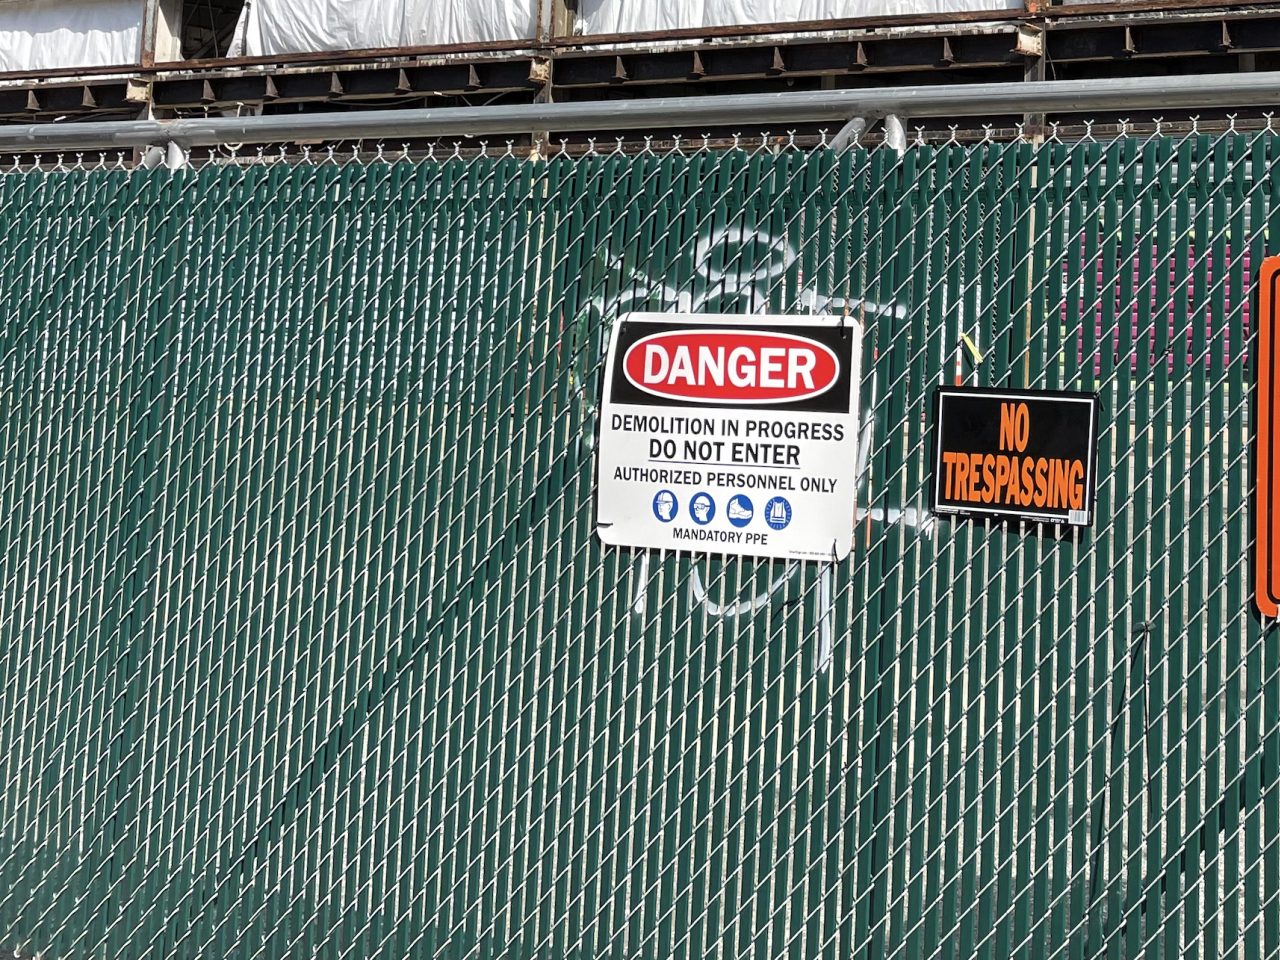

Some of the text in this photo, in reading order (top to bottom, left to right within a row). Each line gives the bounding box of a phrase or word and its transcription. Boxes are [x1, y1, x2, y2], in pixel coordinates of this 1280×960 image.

[643, 344, 816, 390] DANGER
[611, 414, 844, 441] DEMOLITION IN PROGRESS
[999, 402, 1030, 453] NO
[649, 439, 800, 466] DO NOT ENTER
[614, 466, 838, 493] AUTHORIZED PERSONNEL ONLY
[943, 452, 1084, 510] TRESPASSING
[673, 527, 768, 545] MANDATORY PPE
